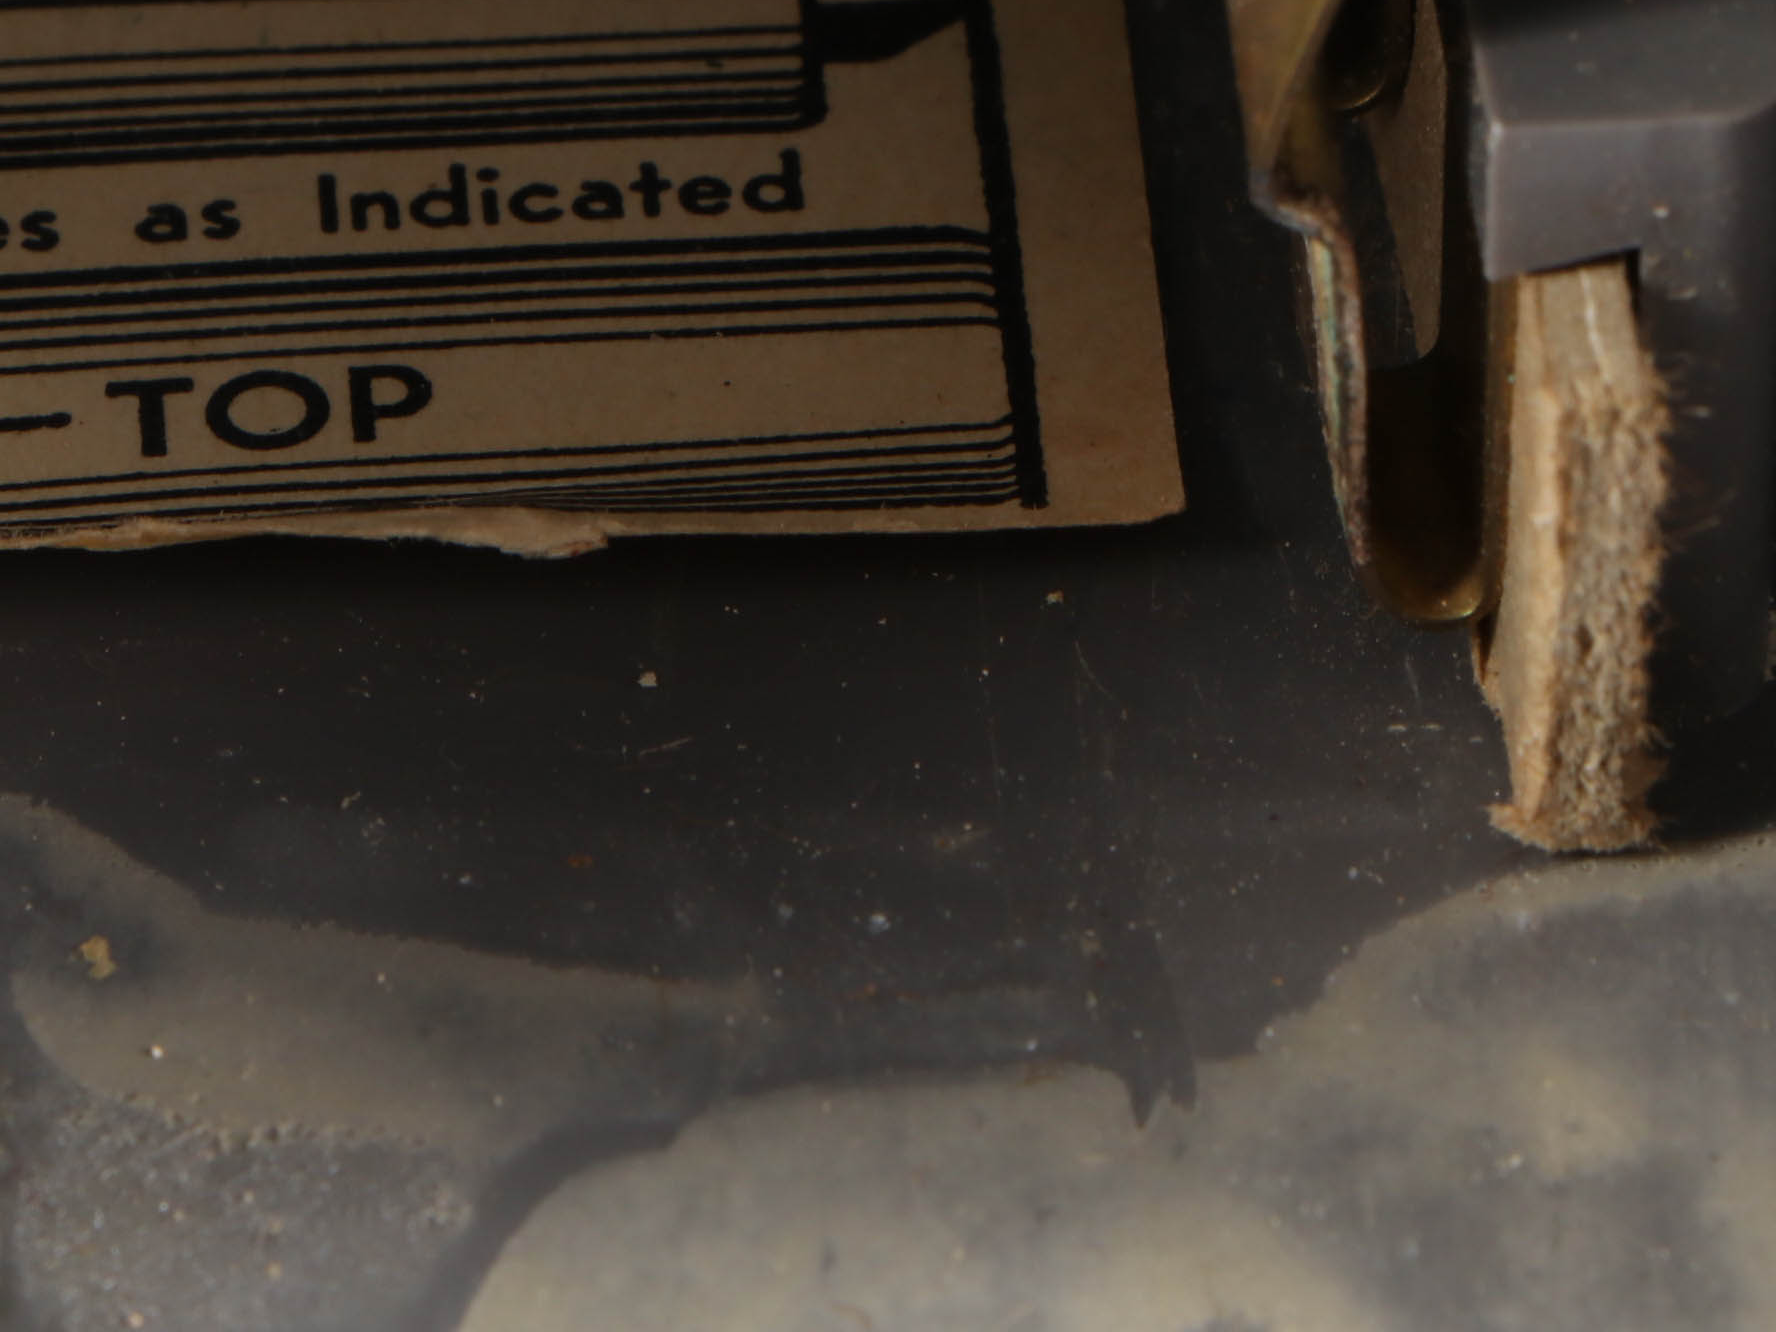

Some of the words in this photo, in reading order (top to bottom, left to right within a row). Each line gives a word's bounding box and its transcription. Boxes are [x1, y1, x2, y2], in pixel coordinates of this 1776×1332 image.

[133, 199, 241, 245] as
[317, 148, 805, 235] Indicated
[104, 365, 433, 458] TOP
